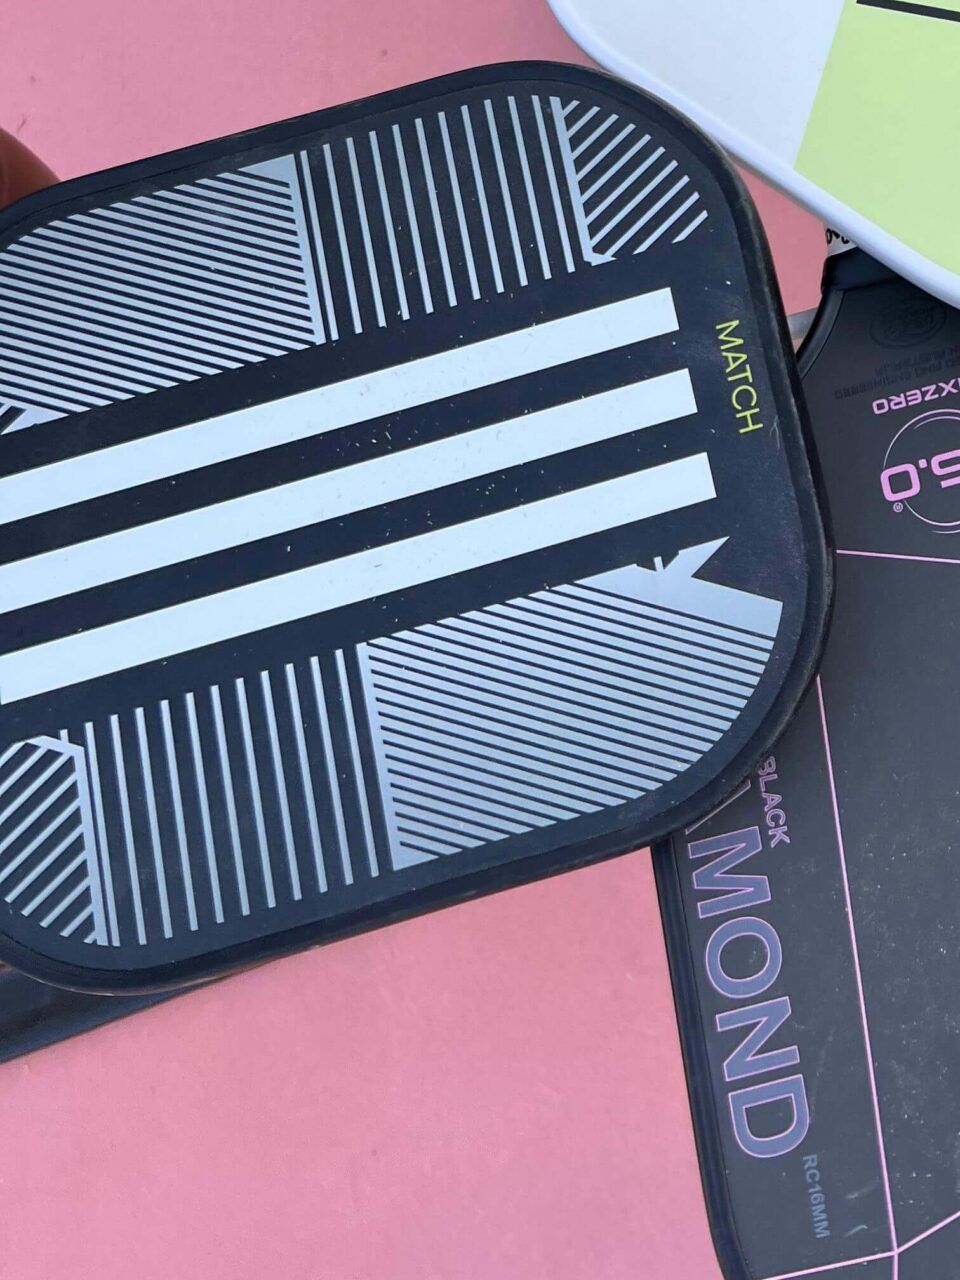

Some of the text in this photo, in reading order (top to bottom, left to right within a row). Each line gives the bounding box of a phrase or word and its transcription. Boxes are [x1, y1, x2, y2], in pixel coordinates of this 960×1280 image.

[716, 320, 763, 434] MATCH
[758, 756, 790, 848] BLACK
[685, 781, 810, 1158] MOND
[802, 1154, 831, 1239] RC16MM
